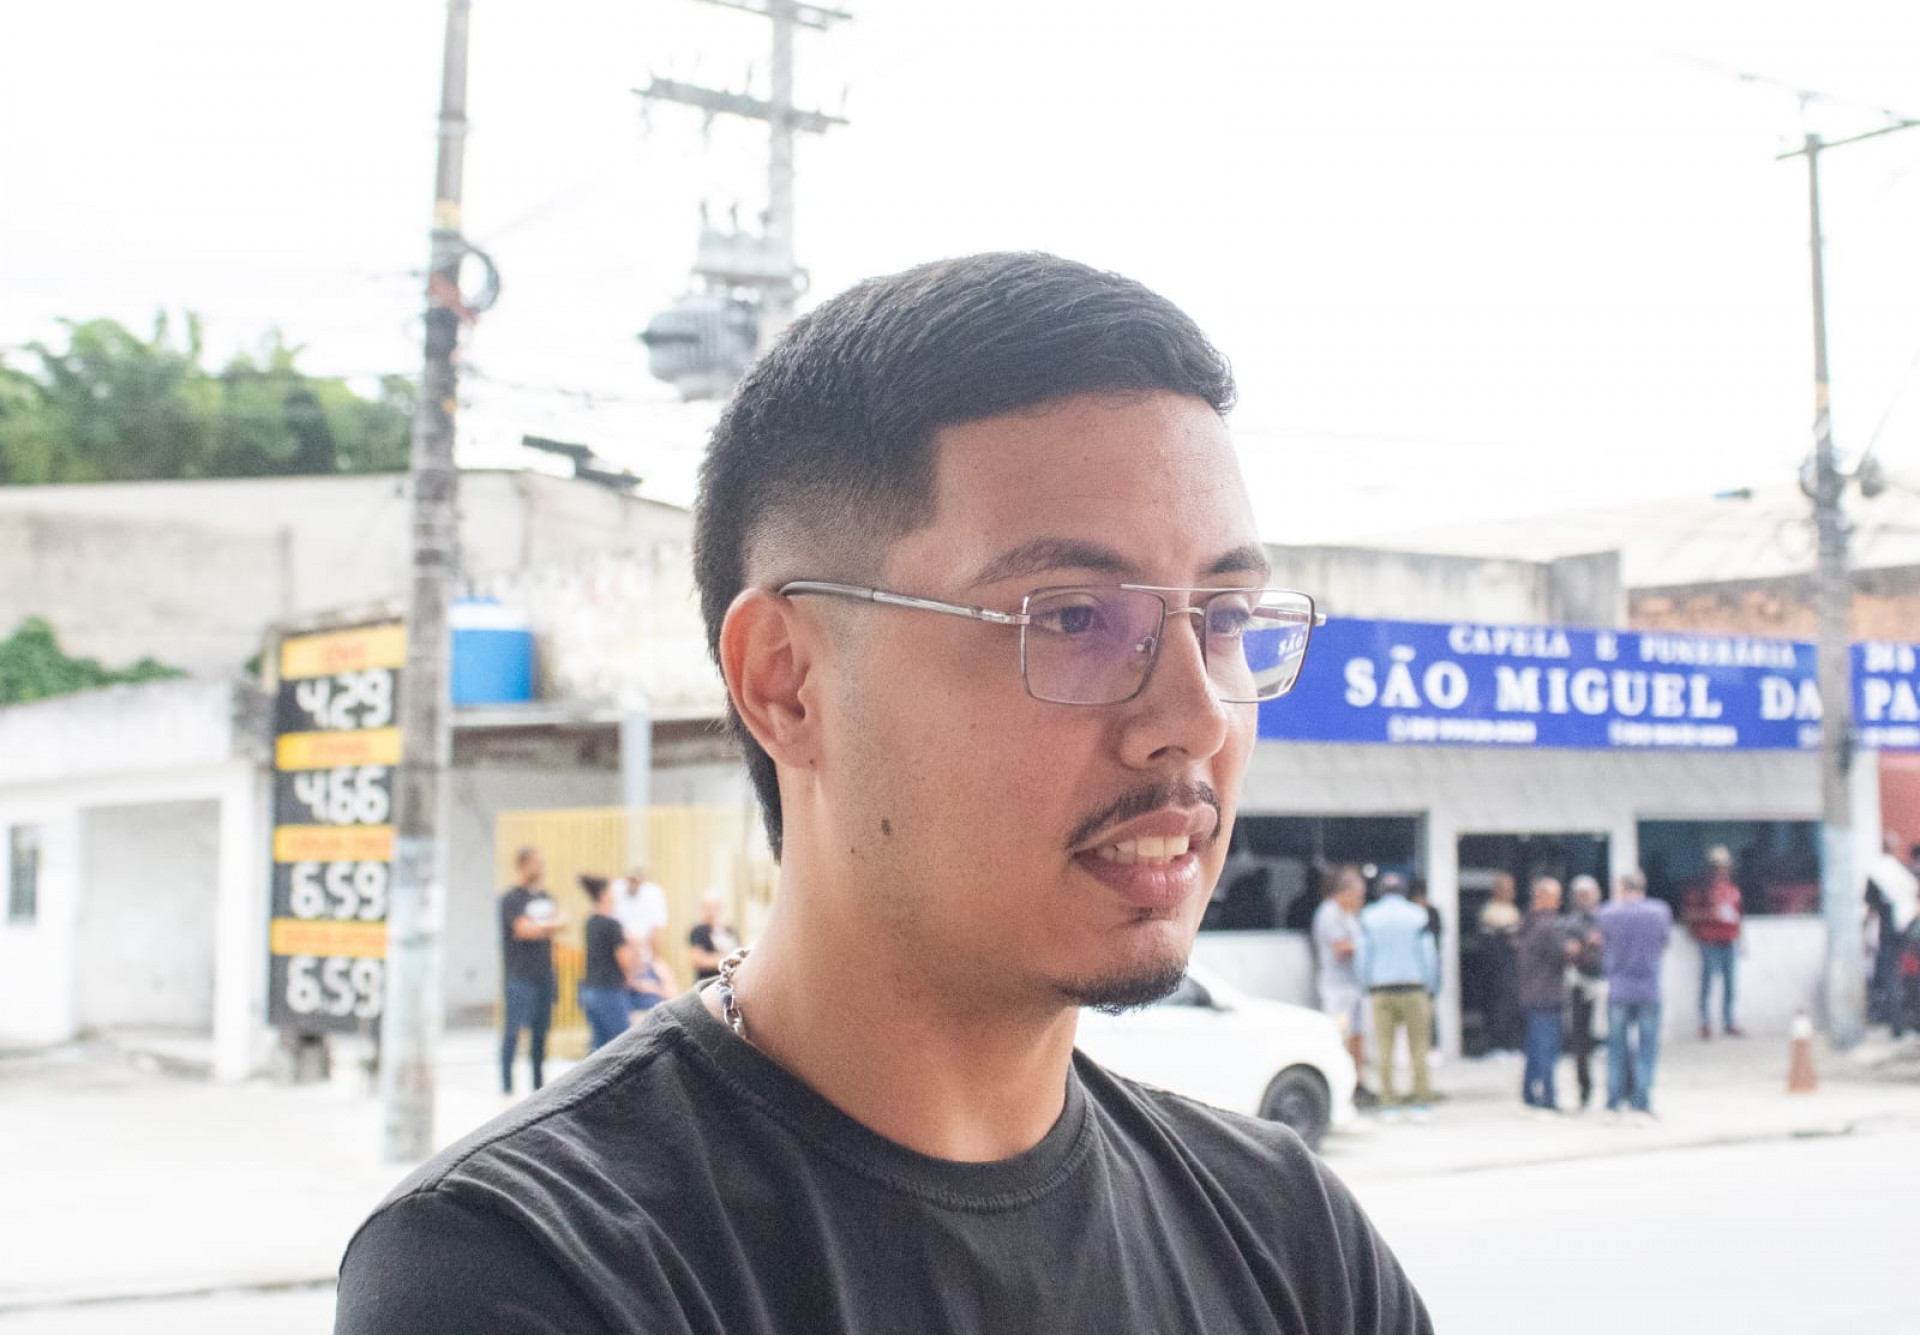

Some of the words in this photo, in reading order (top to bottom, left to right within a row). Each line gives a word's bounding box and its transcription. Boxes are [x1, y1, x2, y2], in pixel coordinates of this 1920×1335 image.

[1449, 624, 1572, 659] CAPELA
[1344, 644, 1469, 709] SÃO
[1494, 663, 1723, 718] MIGUEL
[1759, 674, 1824, 720] DA
[1862, 676, 1920, 721] PA
